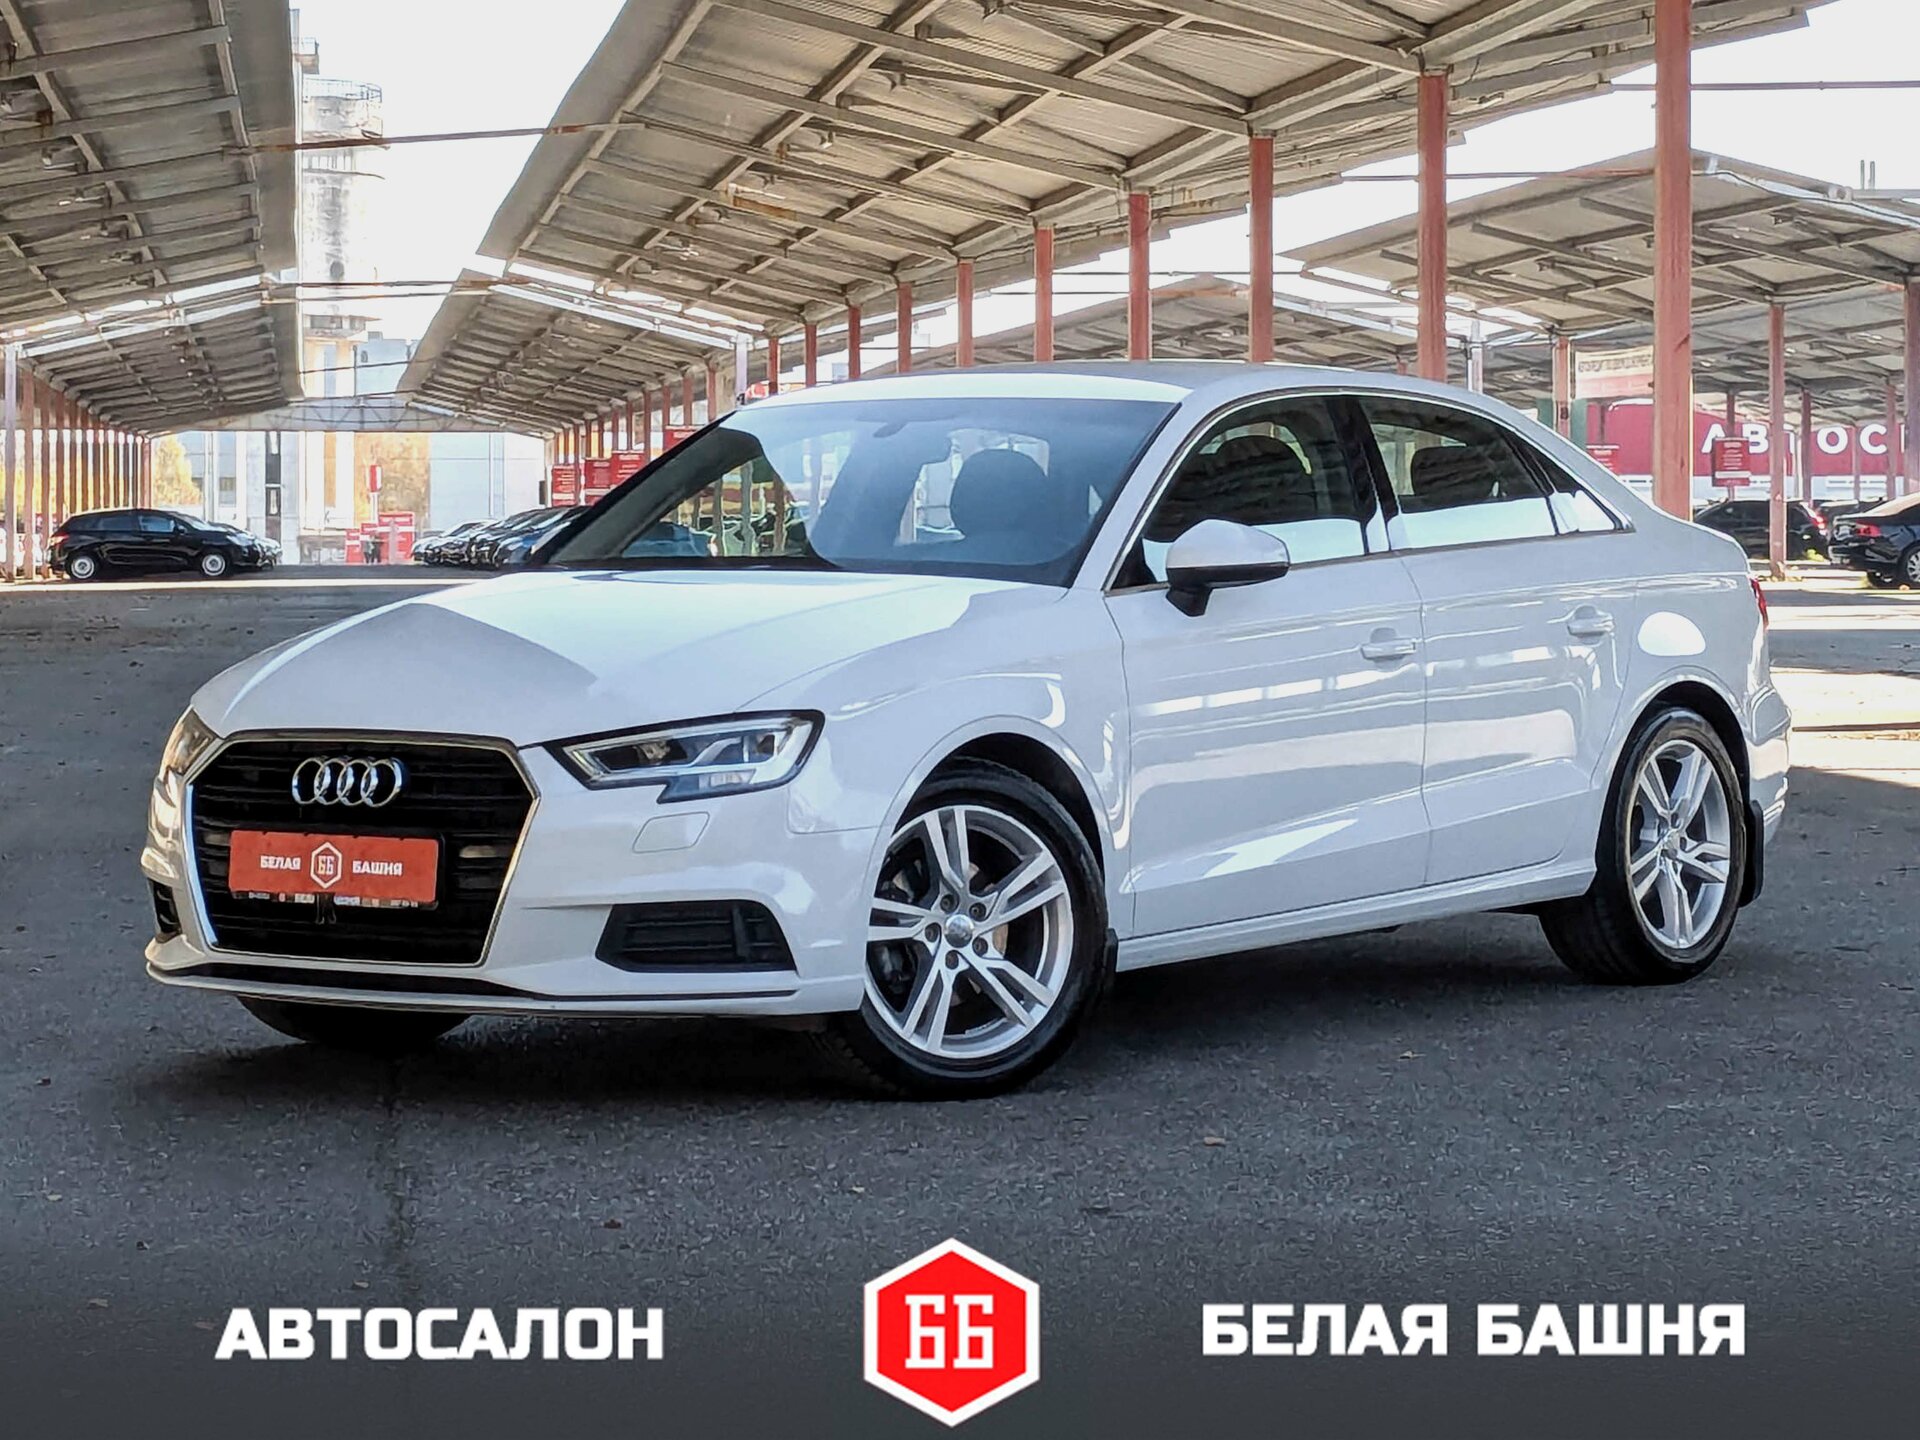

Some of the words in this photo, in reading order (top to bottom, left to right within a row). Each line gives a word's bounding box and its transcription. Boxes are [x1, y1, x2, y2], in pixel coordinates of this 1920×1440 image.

[1701, 423, 1905, 454] АВОС
[260, 855, 301, 870] БЕЛАЯ
[352, 860, 403, 876] БАШНЯ
